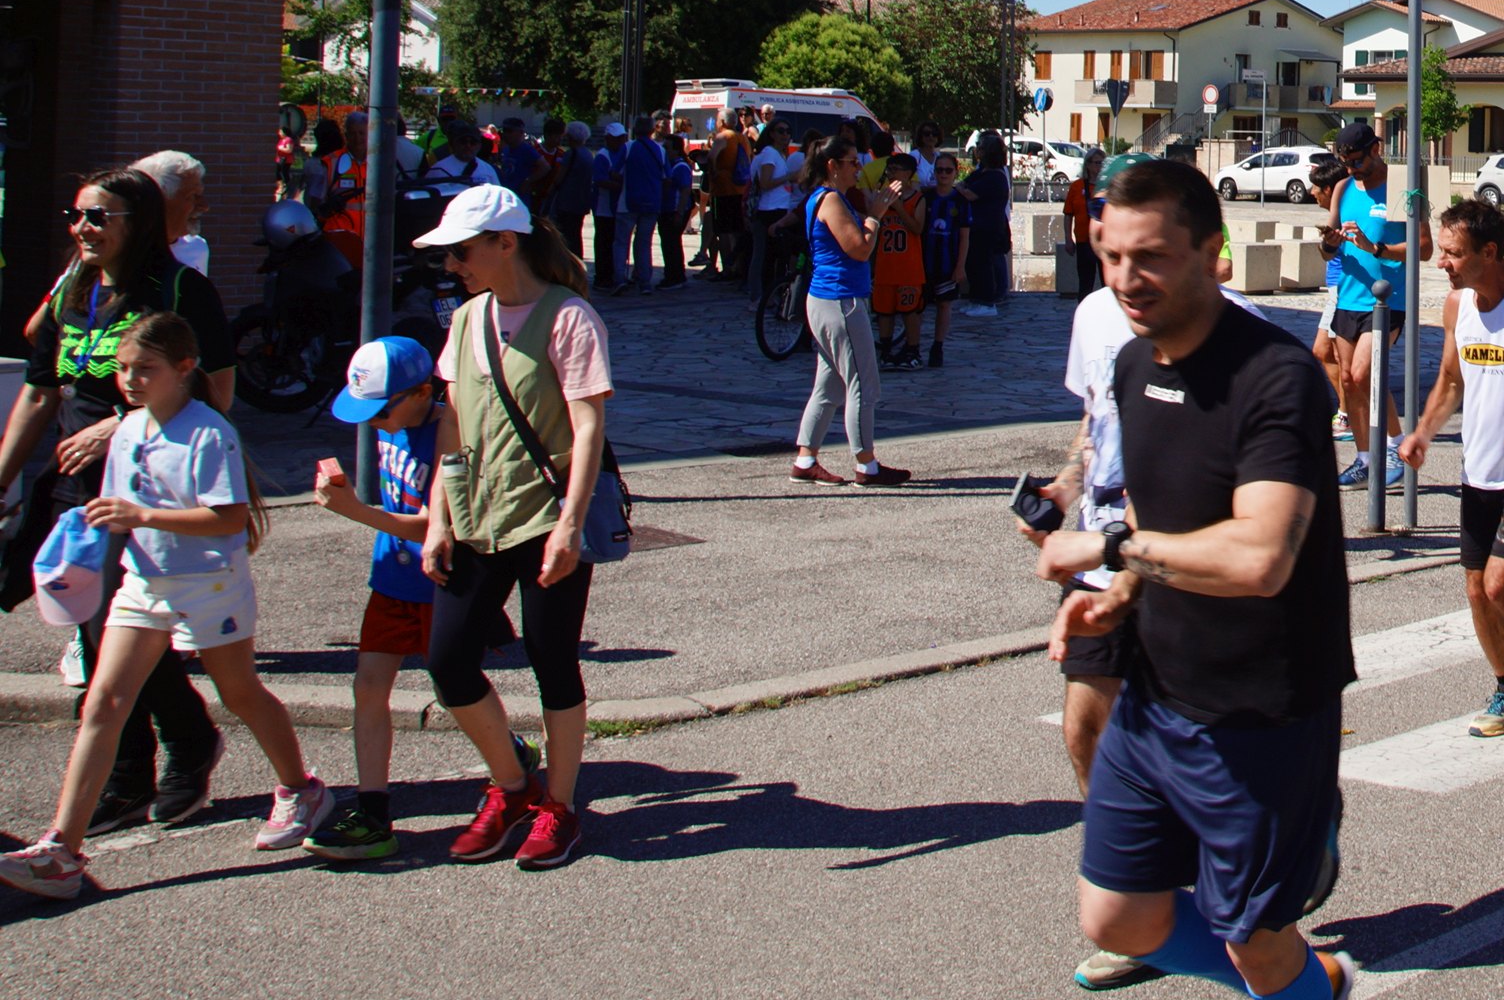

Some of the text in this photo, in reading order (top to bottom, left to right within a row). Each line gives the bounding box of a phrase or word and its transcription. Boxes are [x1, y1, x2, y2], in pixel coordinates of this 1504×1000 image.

[683, 95, 720, 104] AMBULANZA
[759, 95, 785, 104] PUBBLICA
[883, 229, 907, 252] 20
[901, 294, 915, 306] 20
